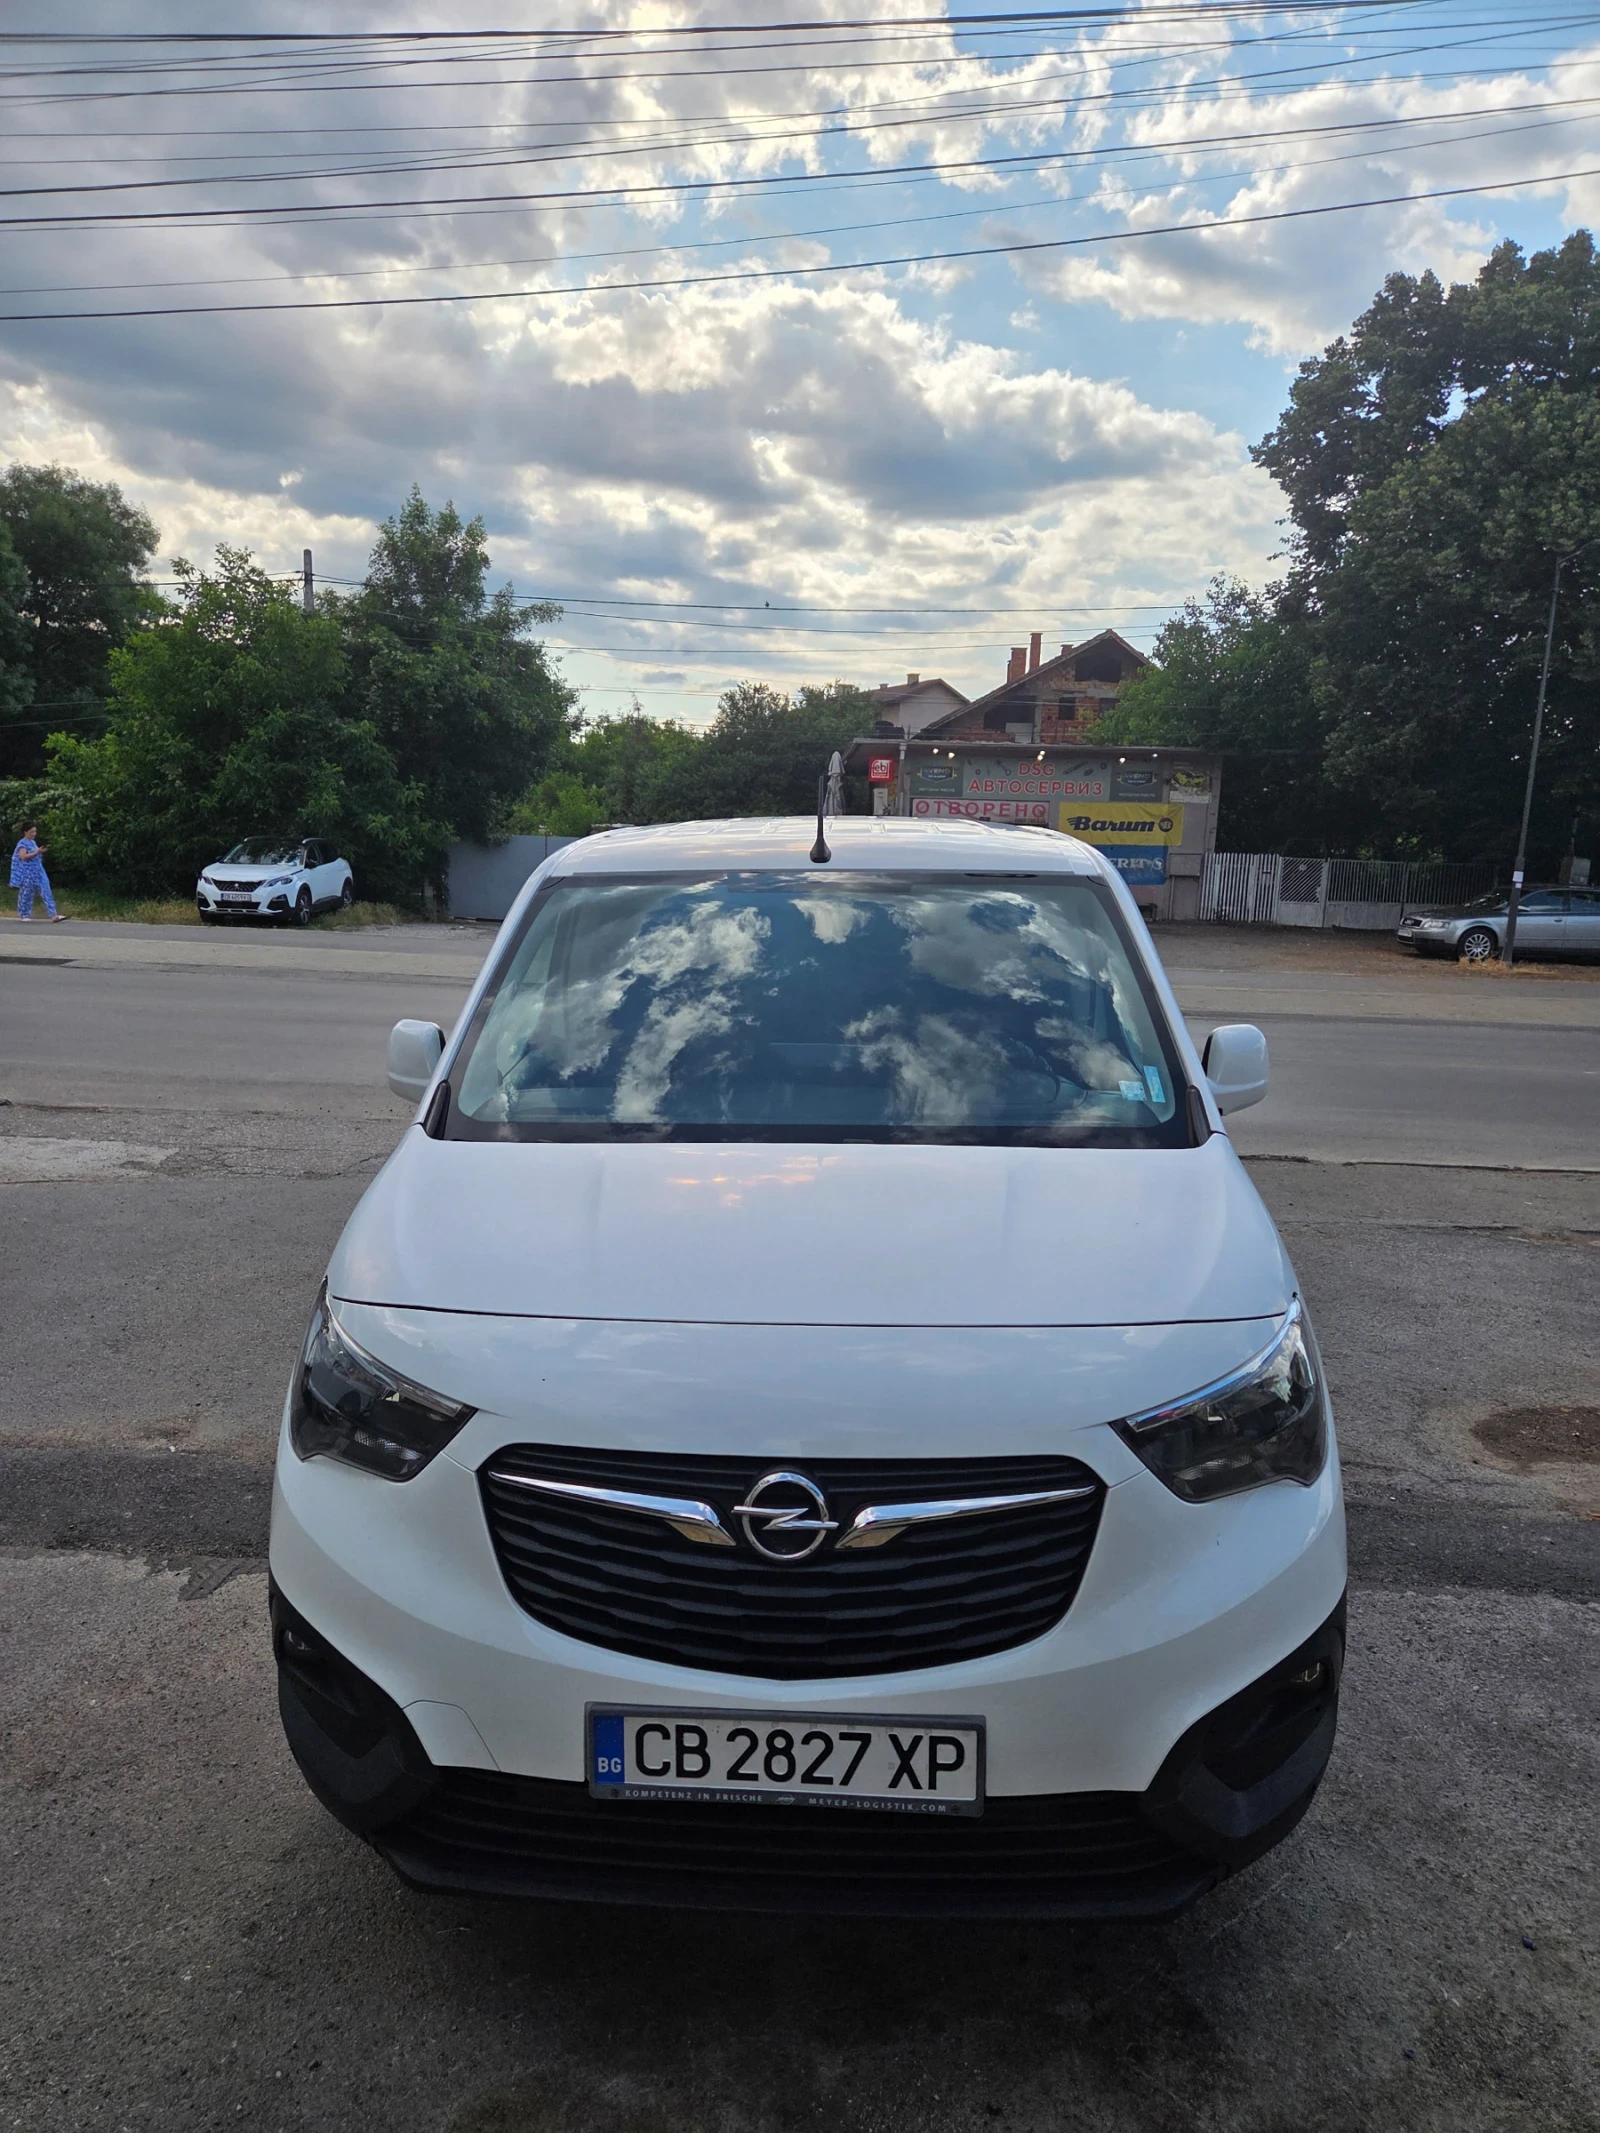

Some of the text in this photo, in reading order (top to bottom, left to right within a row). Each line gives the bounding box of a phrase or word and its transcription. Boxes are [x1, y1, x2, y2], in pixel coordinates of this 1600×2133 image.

[1018, 763, 1055, 776] DSG
[967, 779, 1104, 796] АВТОСЕРВИЗ
[915, 800, 1047, 817] ОТВОРЕНО
[1067, 816, 1154, 832] Barum
[635, 1723, 965, 1791] CB 2827 XP
[597, 1757, 622, 1774] BG
[625, 1789, 763, 1802] KOMPETENZ IN FRISCHE
[808, 1797, 947, 1813] MEYER-LOGISTIK.COM
